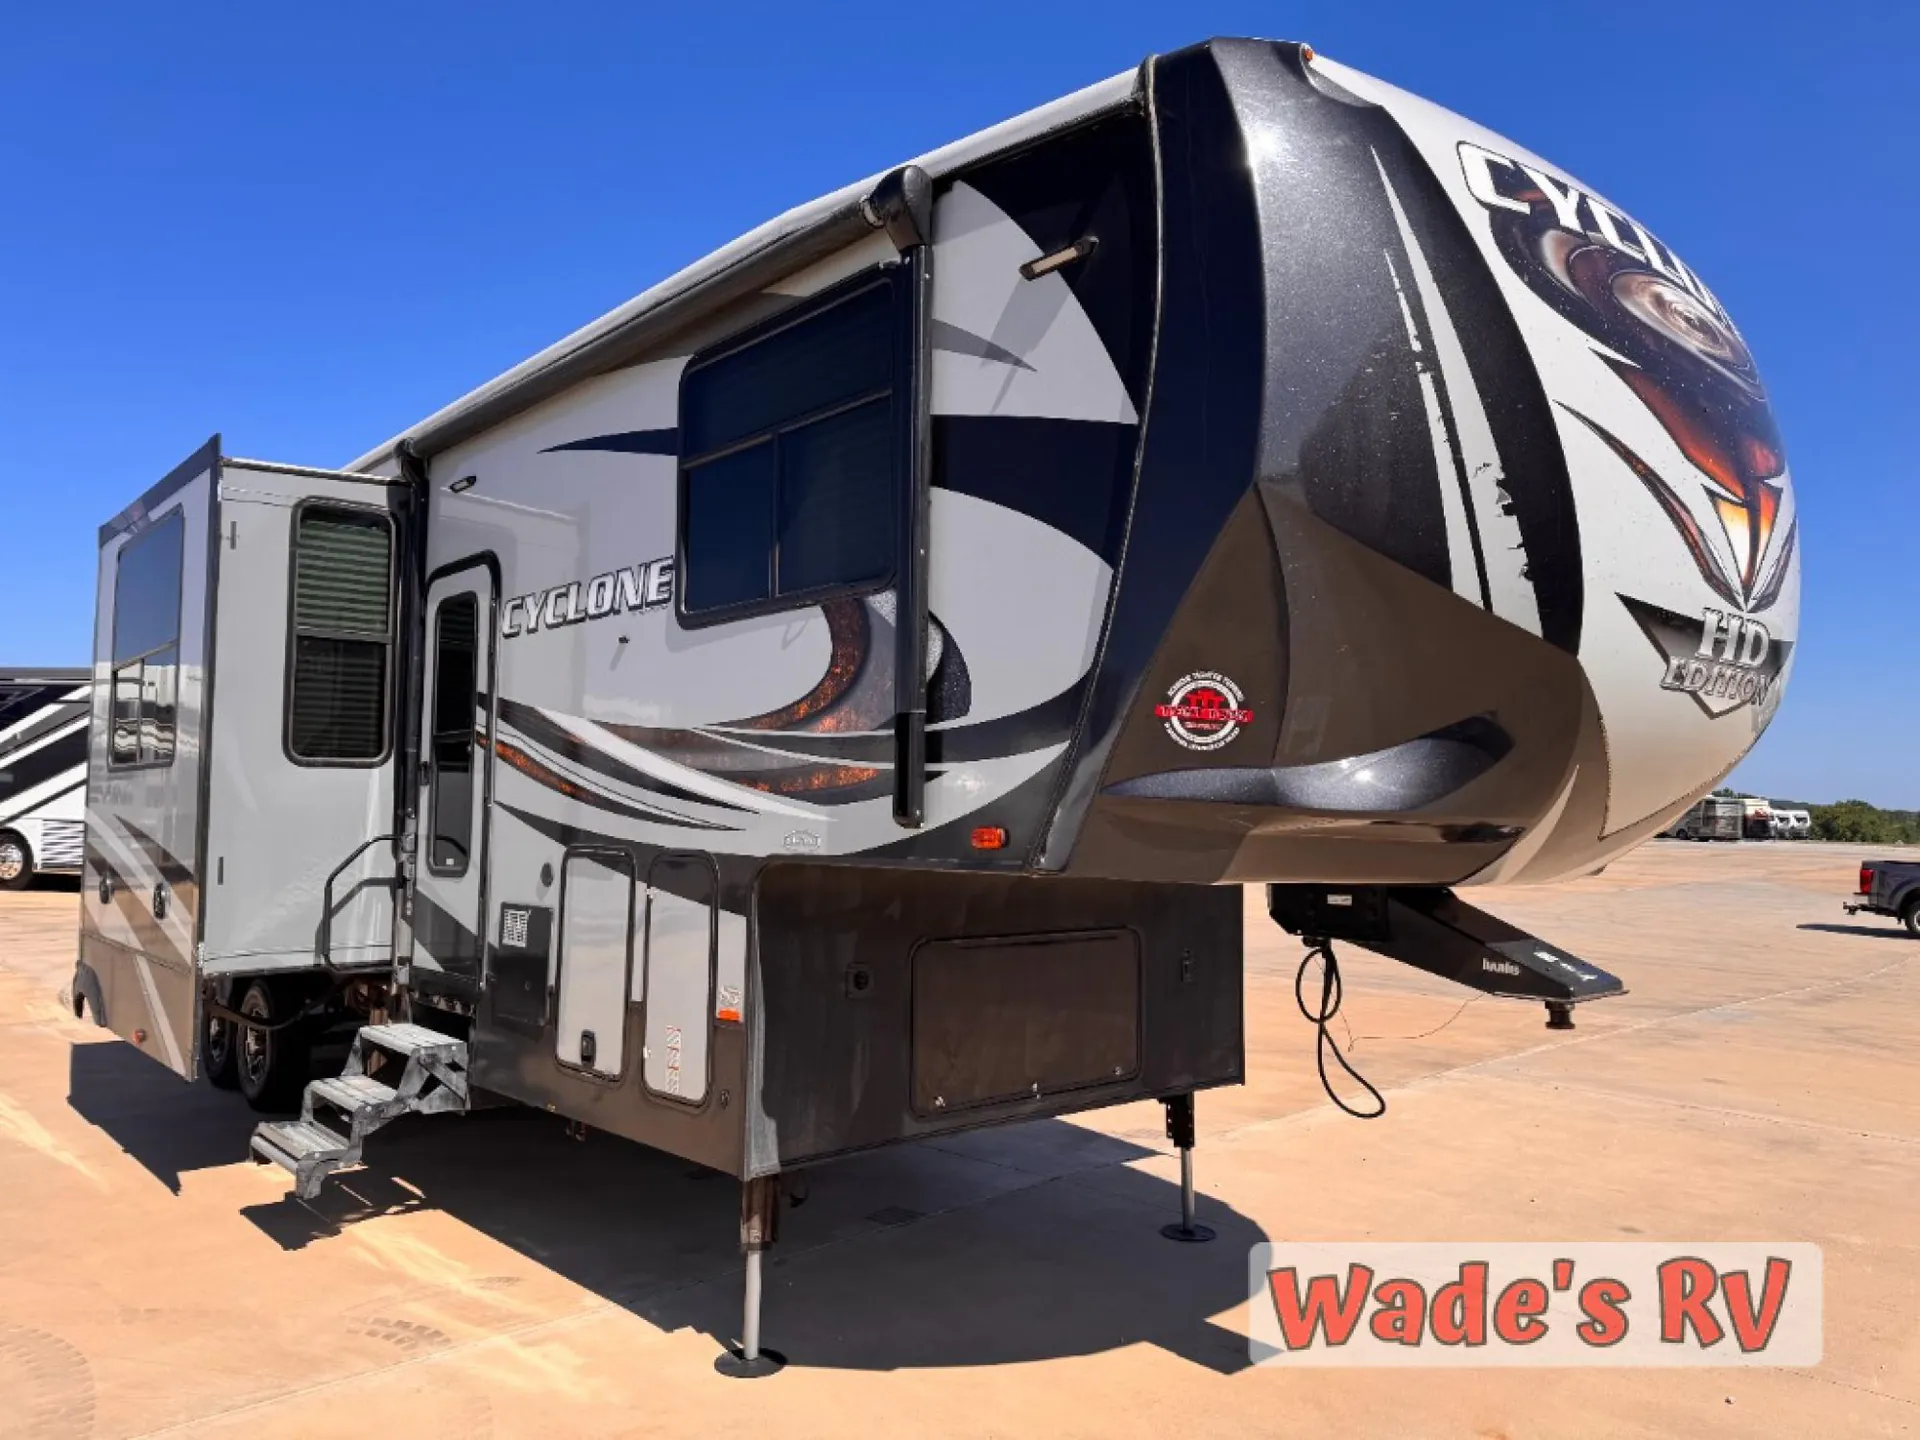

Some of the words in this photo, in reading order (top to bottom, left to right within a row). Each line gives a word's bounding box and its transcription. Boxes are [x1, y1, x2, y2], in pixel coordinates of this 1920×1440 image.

[502, 555, 674, 639] CYCLONE
[1694, 606, 1771, 668] HD
[1660, 655, 1780, 706] EDITION
